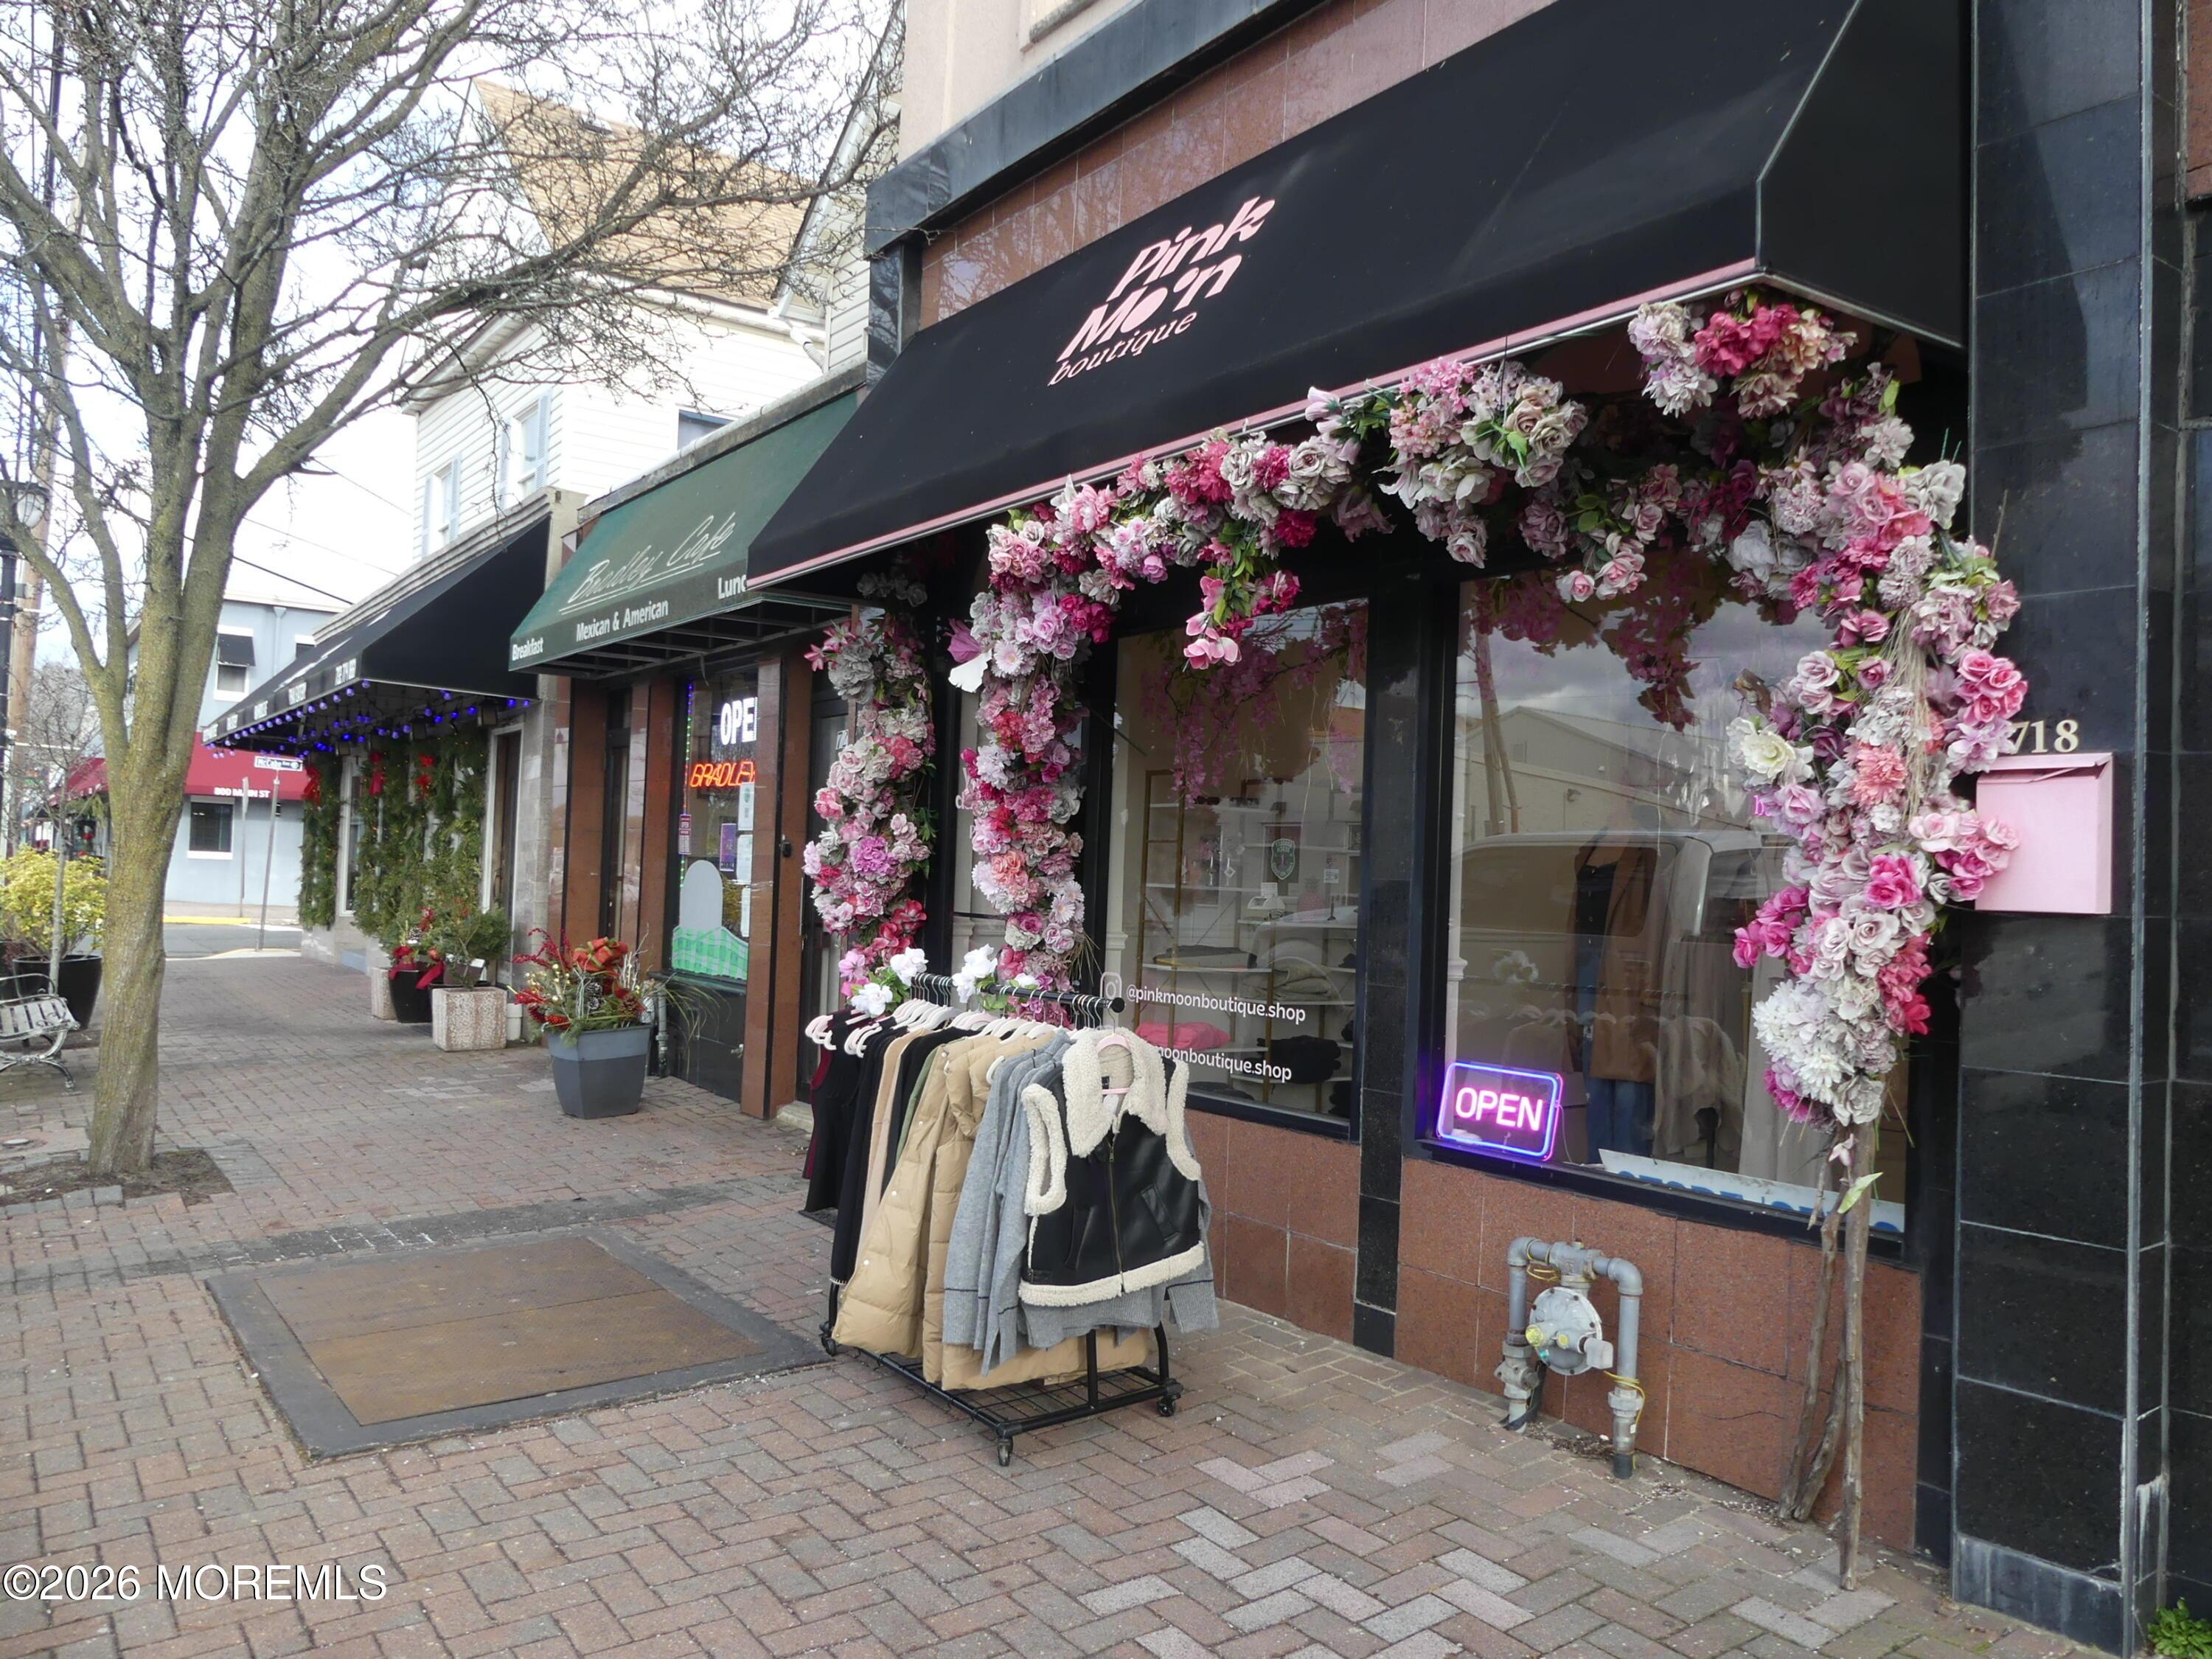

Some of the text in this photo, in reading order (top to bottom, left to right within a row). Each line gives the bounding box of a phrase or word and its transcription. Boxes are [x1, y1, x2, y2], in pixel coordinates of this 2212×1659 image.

[1106, 196, 1276, 302] Pink
[1057, 254, 1242, 363] Moon
[1047, 311, 1197, 386] boutique
[567, 545, 664, 603] Bradley
[512, 636, 544, 661] Breakfast
[576, 618, 611, 642] Mexican
[613, 611, 619, 631] &
[622, 599, 669, 629] American
[720, 697, 758, 746] OPE
[2010, 719, 2079, 756] 718
[259, 790, 271, 799] ST
[1126, 984, 1307, 1025] @pinkmoonboutique.shop
[1455, 1086, 1543, 1132] OPEN
